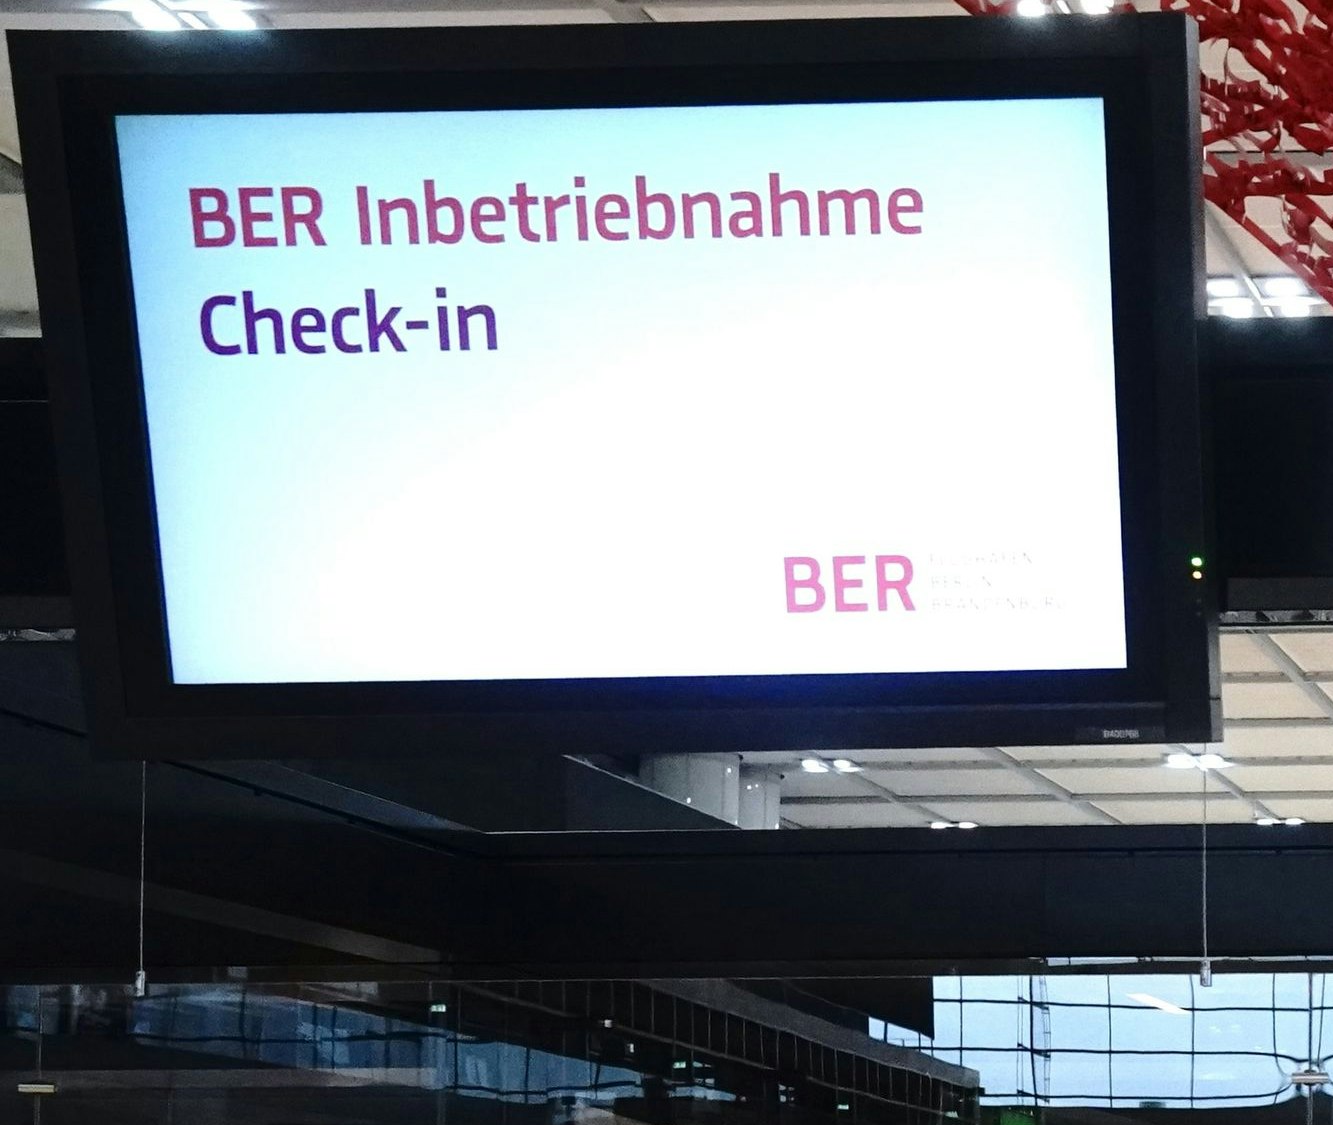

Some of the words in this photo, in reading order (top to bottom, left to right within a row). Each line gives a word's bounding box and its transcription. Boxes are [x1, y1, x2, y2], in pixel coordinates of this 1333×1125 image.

[190, 187, 328, 249] BER
[357, 172, 924, 246] Inbetriebnahme
[199, 286, 499, 356] Check-in
[783, 554, 916, 613] BER
